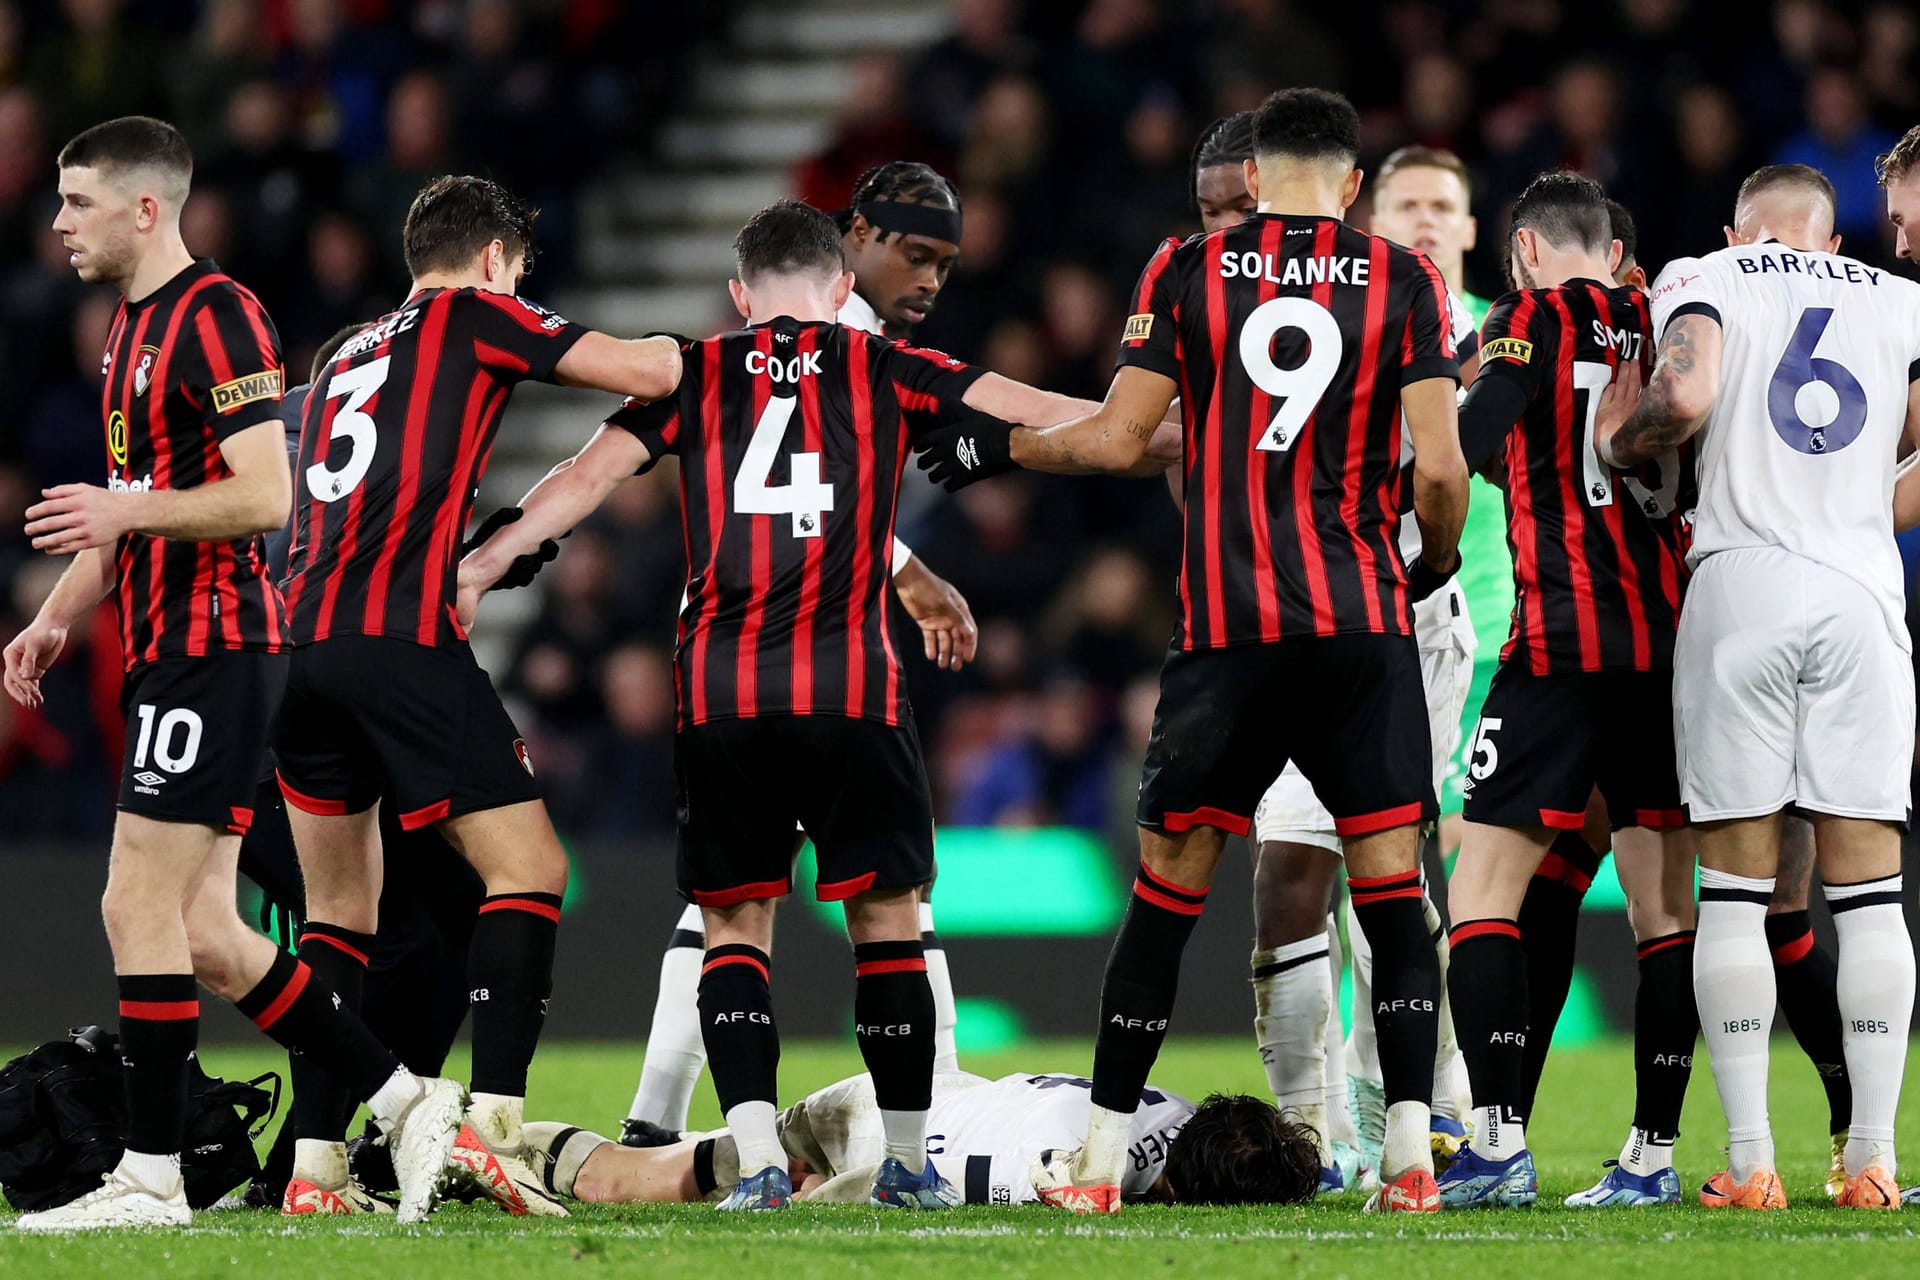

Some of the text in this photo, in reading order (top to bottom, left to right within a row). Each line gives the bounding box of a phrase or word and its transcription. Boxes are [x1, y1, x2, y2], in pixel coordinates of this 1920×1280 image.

[1219, 251, 1370, 285] SOLANKE
[1737, 253, 1880, 286] BARKLEY
[745, 349, 823, 384] COOK
[1239, 296, 1343, 451] 9
[1768, 306, 1868, 455] 6
[306, 355, 391, 502] 3
[734, 394, 834, 538] 4
[133, 704, 203, 774] 10
[1468, 716, 1502, 780] 5
[134, 785, 160, 796] umbro
[715, 1011, 770, 1025] AFCB
[1111, 1013, 1167, 1031] AFCB
[1378, 999, 1433, 1013] AFCB
[856, 1023, 911, 1036] AFCB
[1723, 1018, 1761, 1033] 1885
[1851, 1020, 1889, 1034] 1885
[1128, 1126, 1182, 1172] YER
